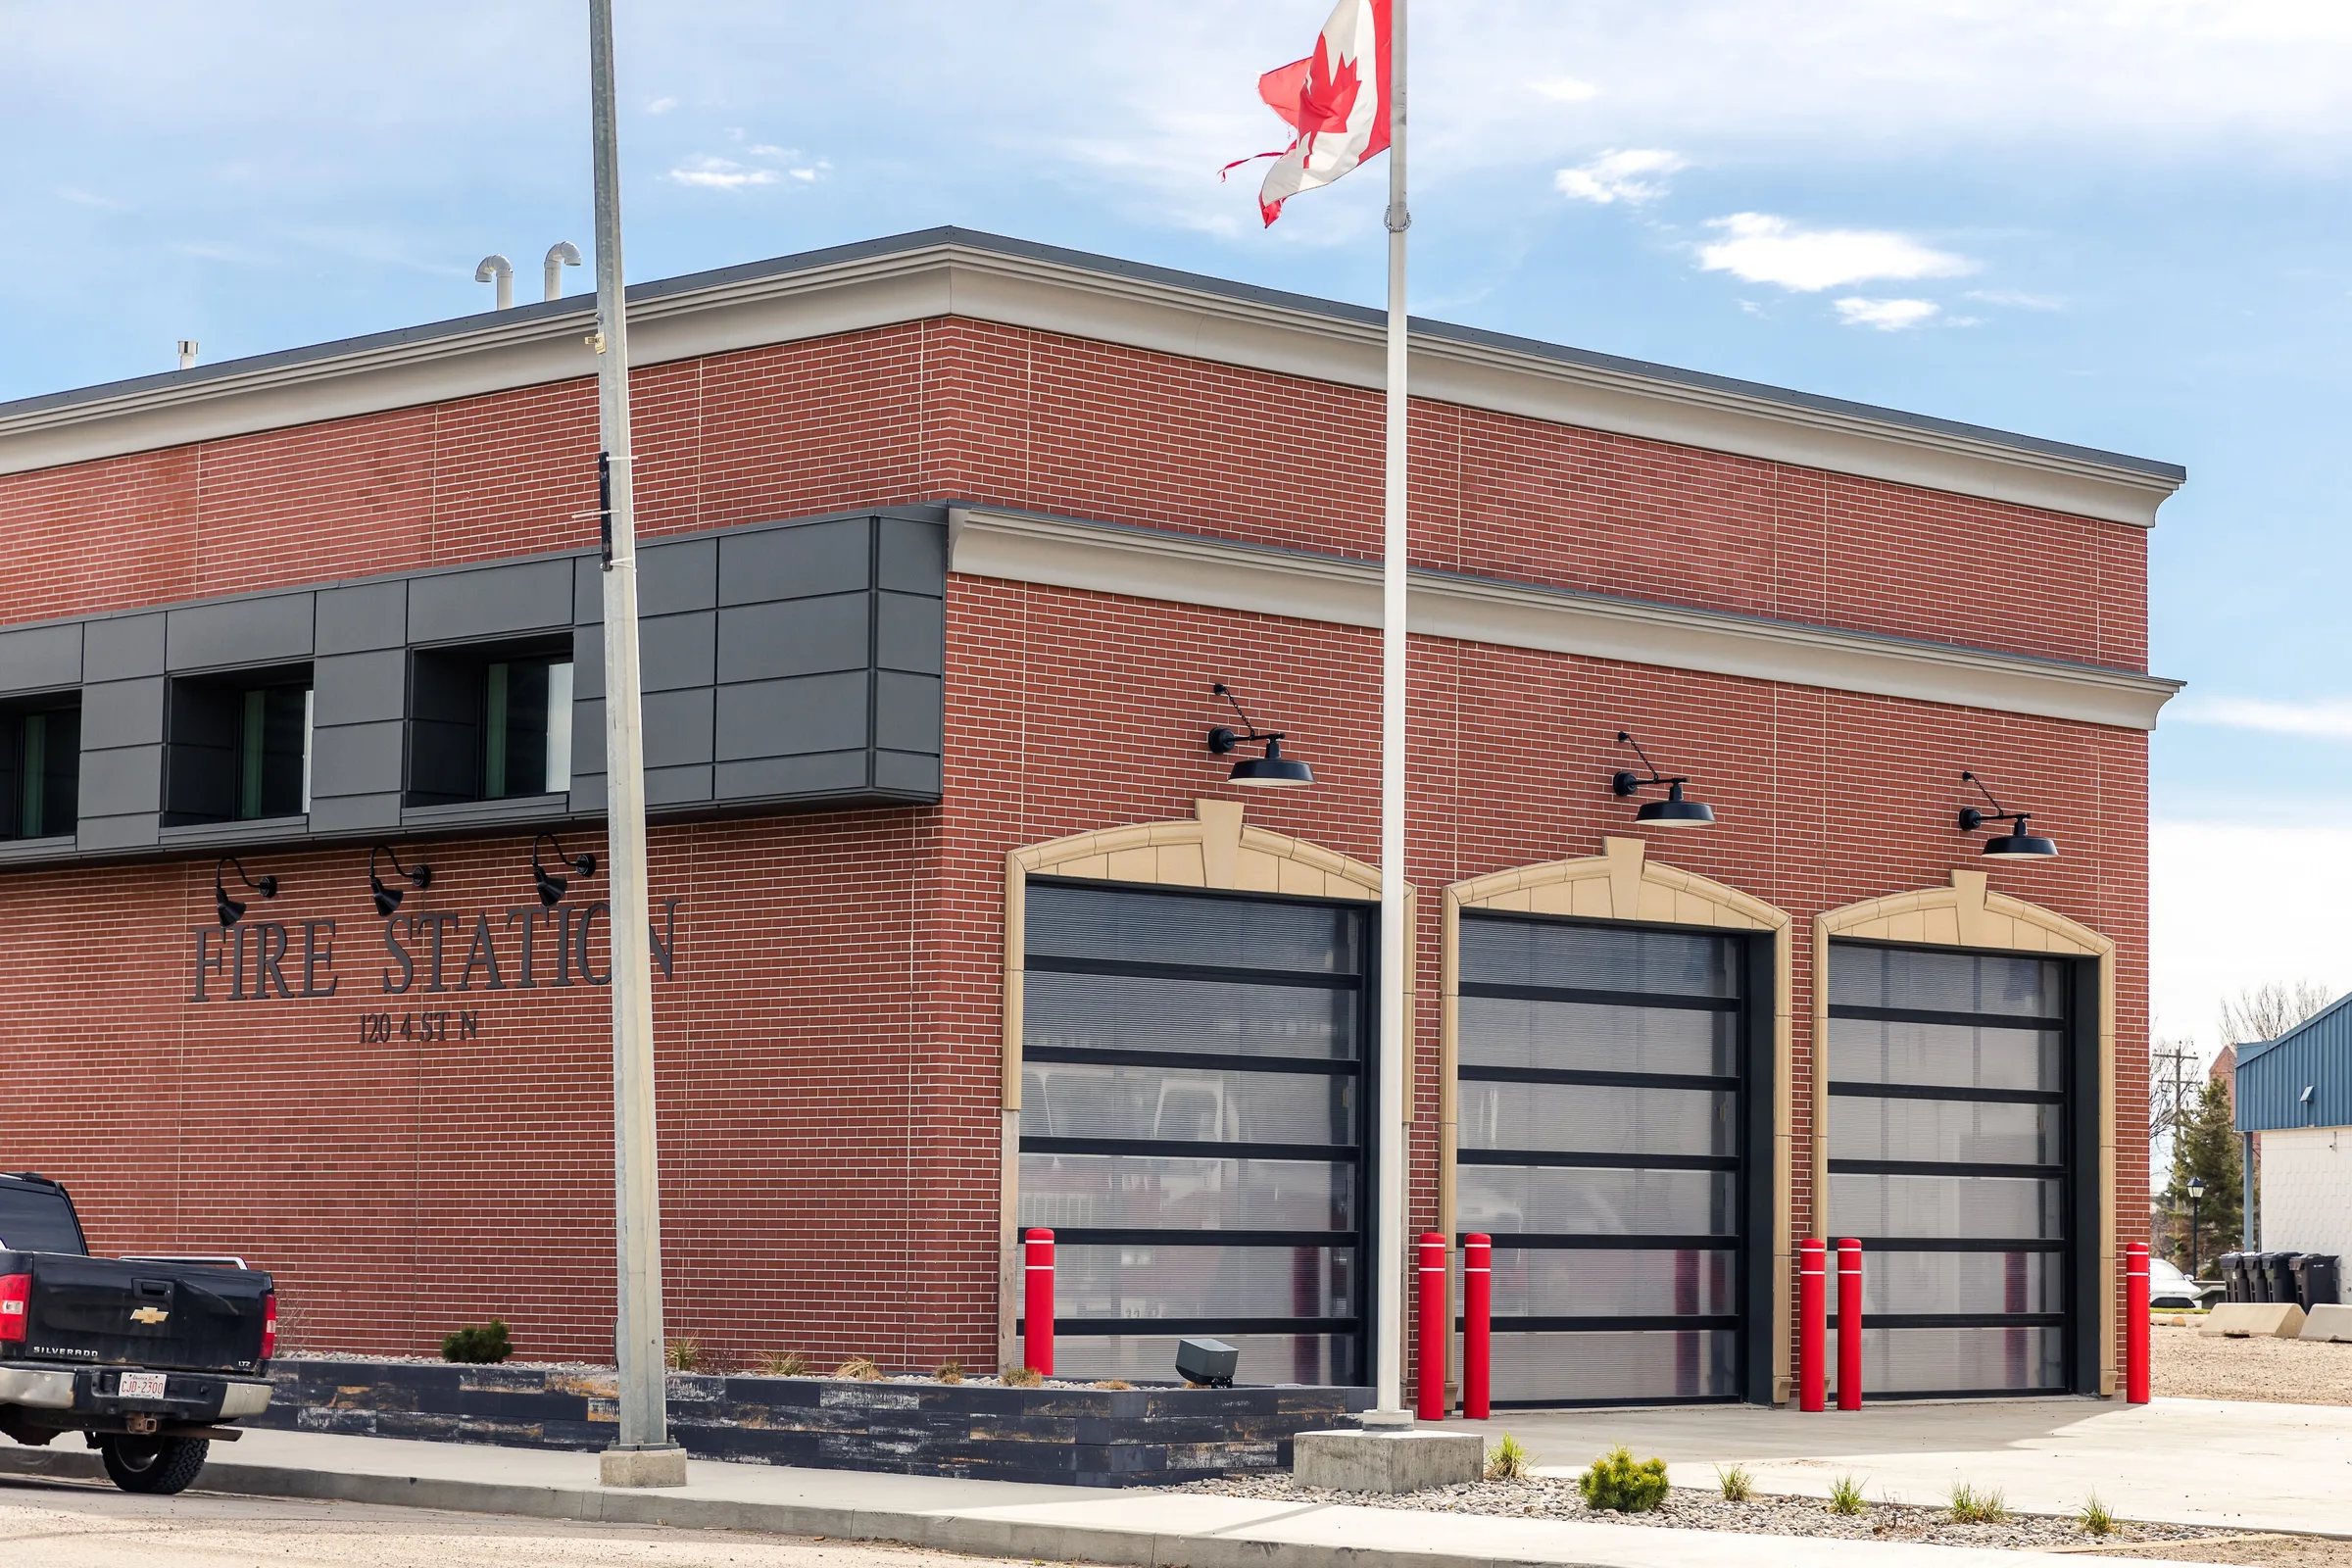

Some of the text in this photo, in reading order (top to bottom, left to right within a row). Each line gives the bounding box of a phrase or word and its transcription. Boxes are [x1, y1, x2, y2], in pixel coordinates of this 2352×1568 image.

[190, 919, 339, 1003] FIRE
[360, 1010, 478, 1043] 120 4 ST N
[33, 1346, 98, 1357] SILVERADO
[121, 1380, 164, 1395] CJD-2300
